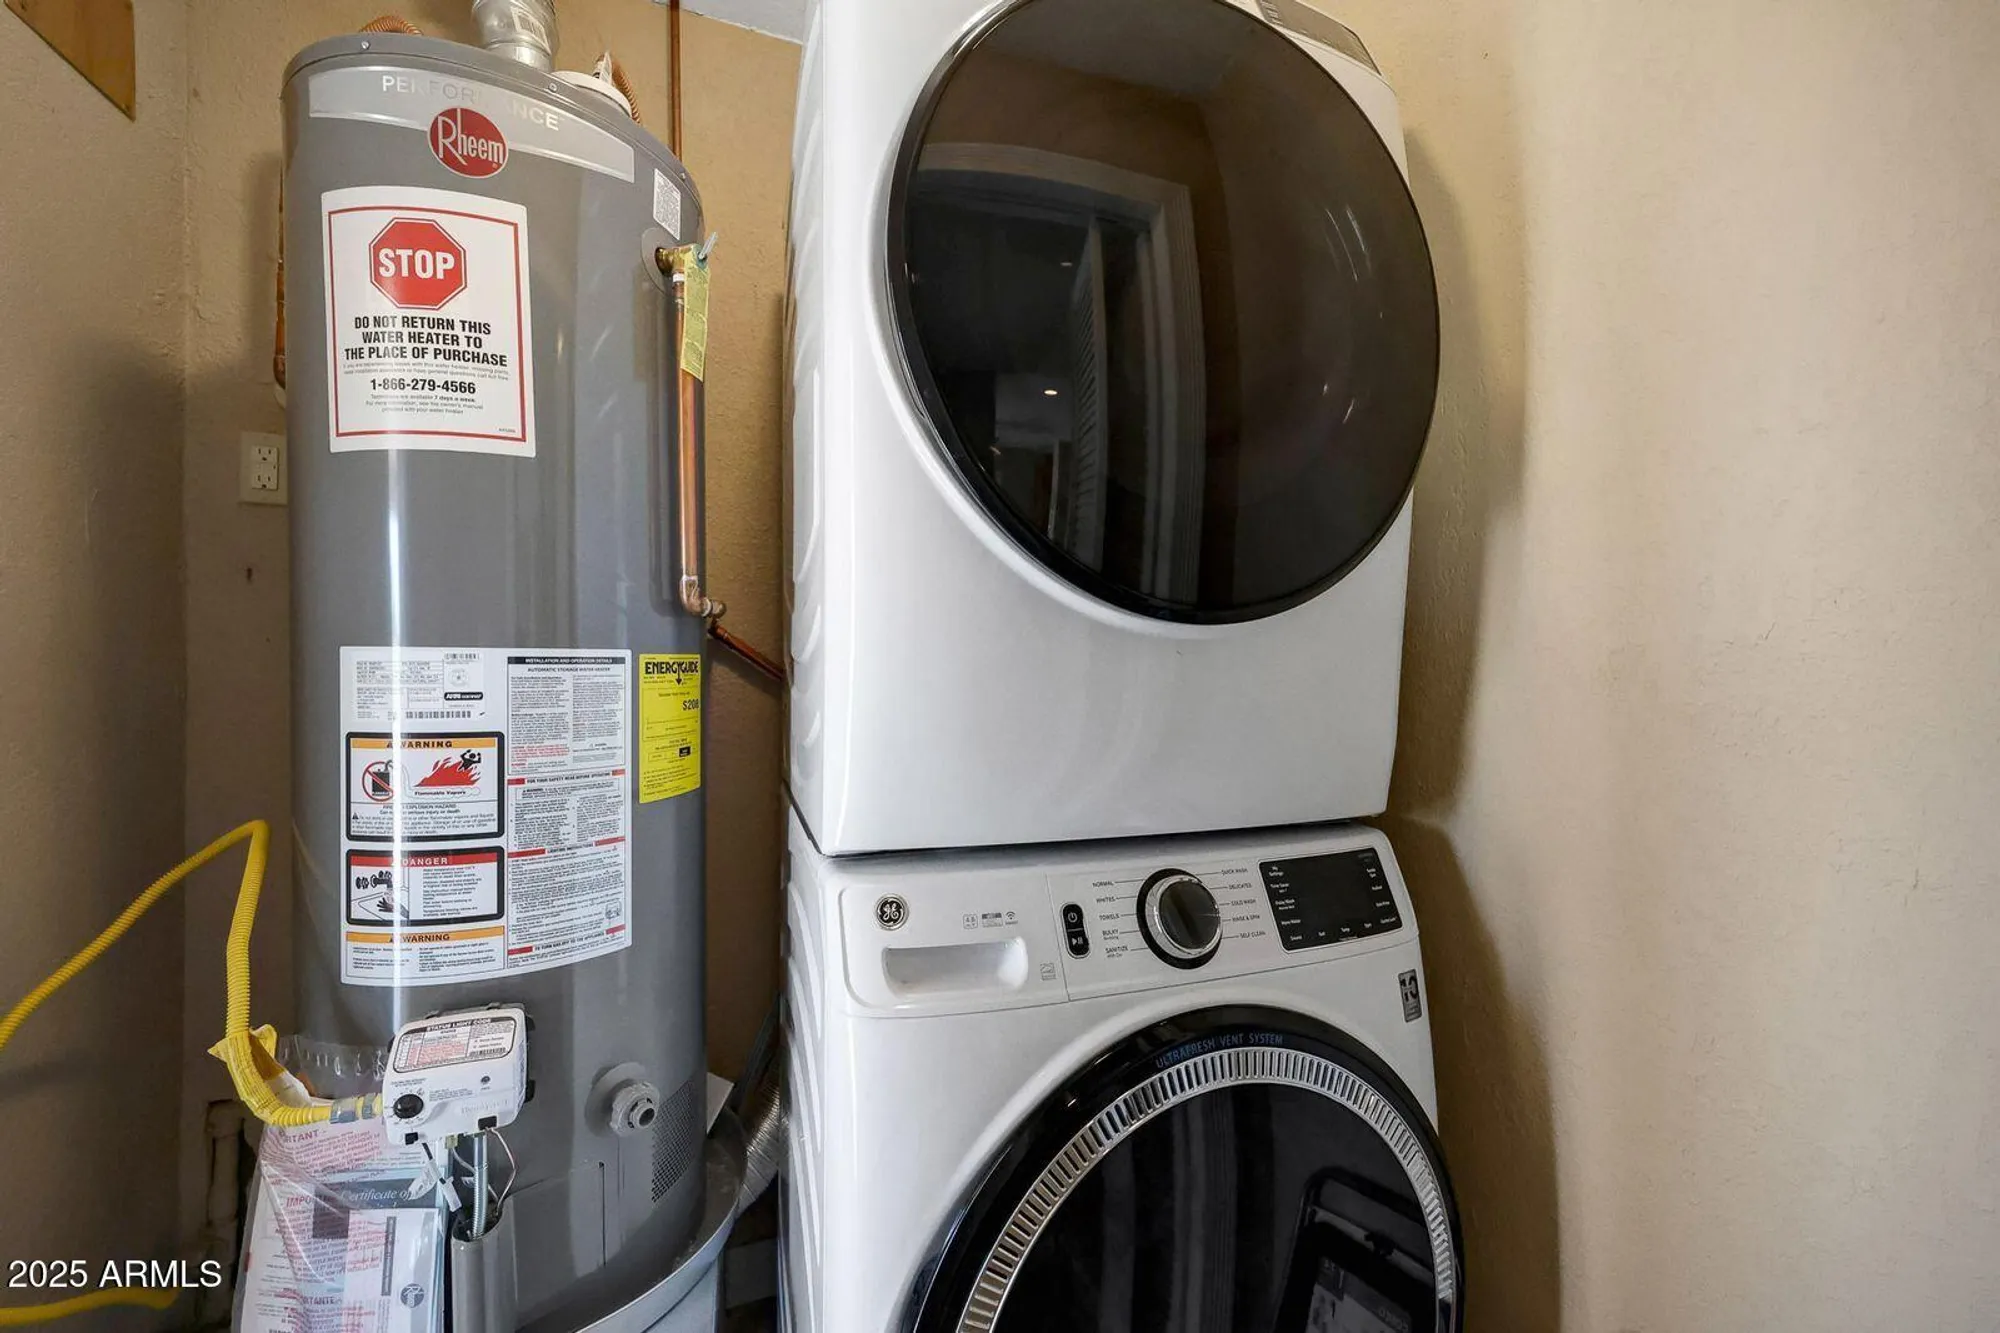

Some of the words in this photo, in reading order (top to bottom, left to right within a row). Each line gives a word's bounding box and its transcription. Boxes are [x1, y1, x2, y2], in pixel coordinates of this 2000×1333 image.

[382, 75, 560, 131] PERFORANCE
[437, 107, 504, 166] Rheem
[378, 247, 455, 280] STOP
[354, 316, 370, 329] DO
[374, 315, 397, 328] NOT
[401, 316, 455, 331] RETURN
[459, 320, 491, 335] THIS
[362, 331, 404, 344] WATER
[408, 332, 460, 347] HEATER
[464, 336, 483, 349] TO
[344, 348, 365, 361] THE
[368, 346, 408, 359] PLACE
[412, 347, 430, 359] OF
[434, 348, 508, 368] PURCHASE
[370, 377, 477, 395] 1-866-279-4566
[401, 856, 448, 866] DANGER
[1099, 912, 1120, 920] TOWELS
[402, 933, 451, 943] WARNING
[1102, 928, 1119, 936] BULKY
[1105, 945, 1129, 954] SANITIZE
[1155, 1038, 1216, 1069] ULTRAFRESH
[1219, 1033, 1245, 1048] VENT
[1249, 1032, 1284, 1046] SYSTEM
[342, 1188, 398, 1202] Certificate
